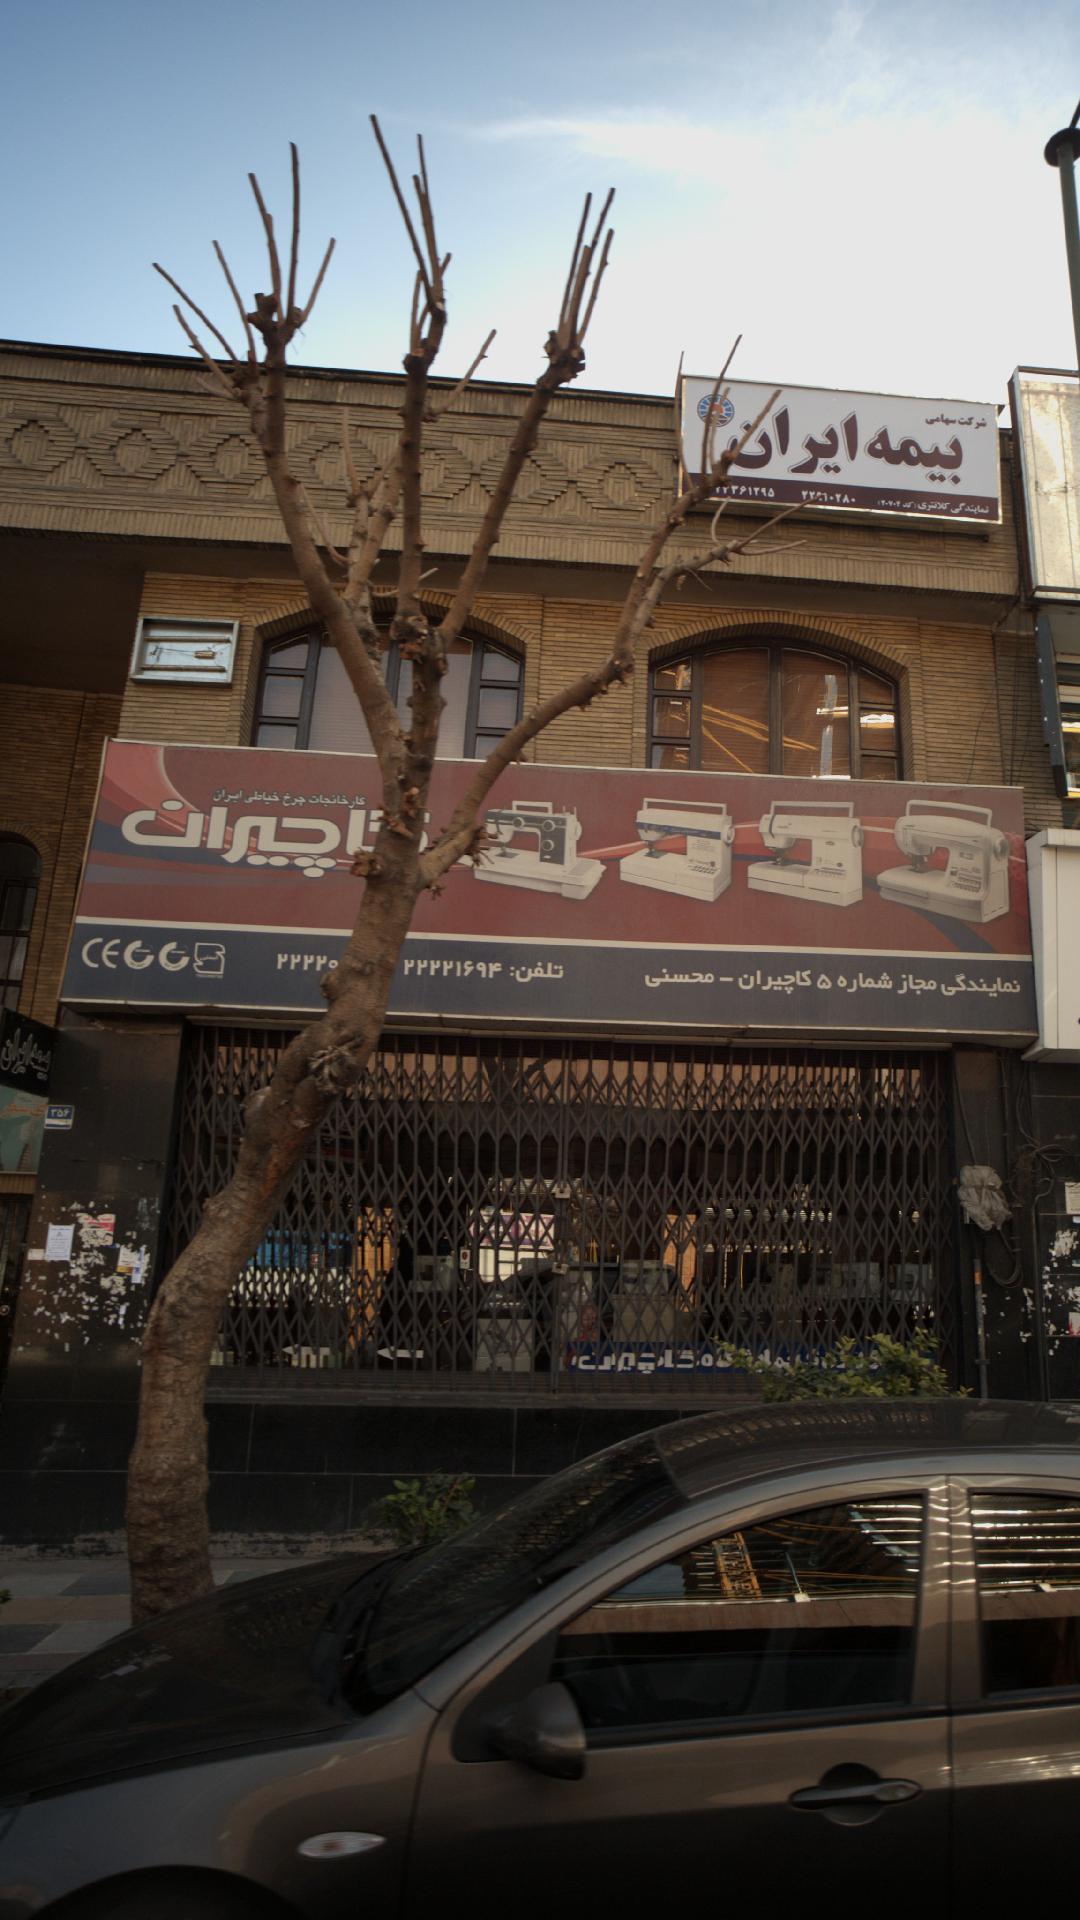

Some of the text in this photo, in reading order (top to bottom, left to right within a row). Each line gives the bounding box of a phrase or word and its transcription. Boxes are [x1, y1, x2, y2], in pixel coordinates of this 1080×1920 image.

[925, 413, 987, 430] شرکت سهامی
[727, 405, 964, 486] بیمه ایران
[951, 502, 990, 515] نمایندگی
[213, 788, 366, 809] کارخانجات چرخ خیاطی ایران
[277, 953, 339, 971] ۲۲۲۲۰
[403, 958, 564, 983] تلفن: ۲۲۲۲۱۶۹۴
[644, 968, 715, 988] محسنی
[737, 970, 812, 995] کاچیران
[816, 974, 832, 989] ۵
[837, 971, 893, 993] شماره
[897, 974, 937, 994] مجاز
[941, 974, 1021, 997] نمایندگی
